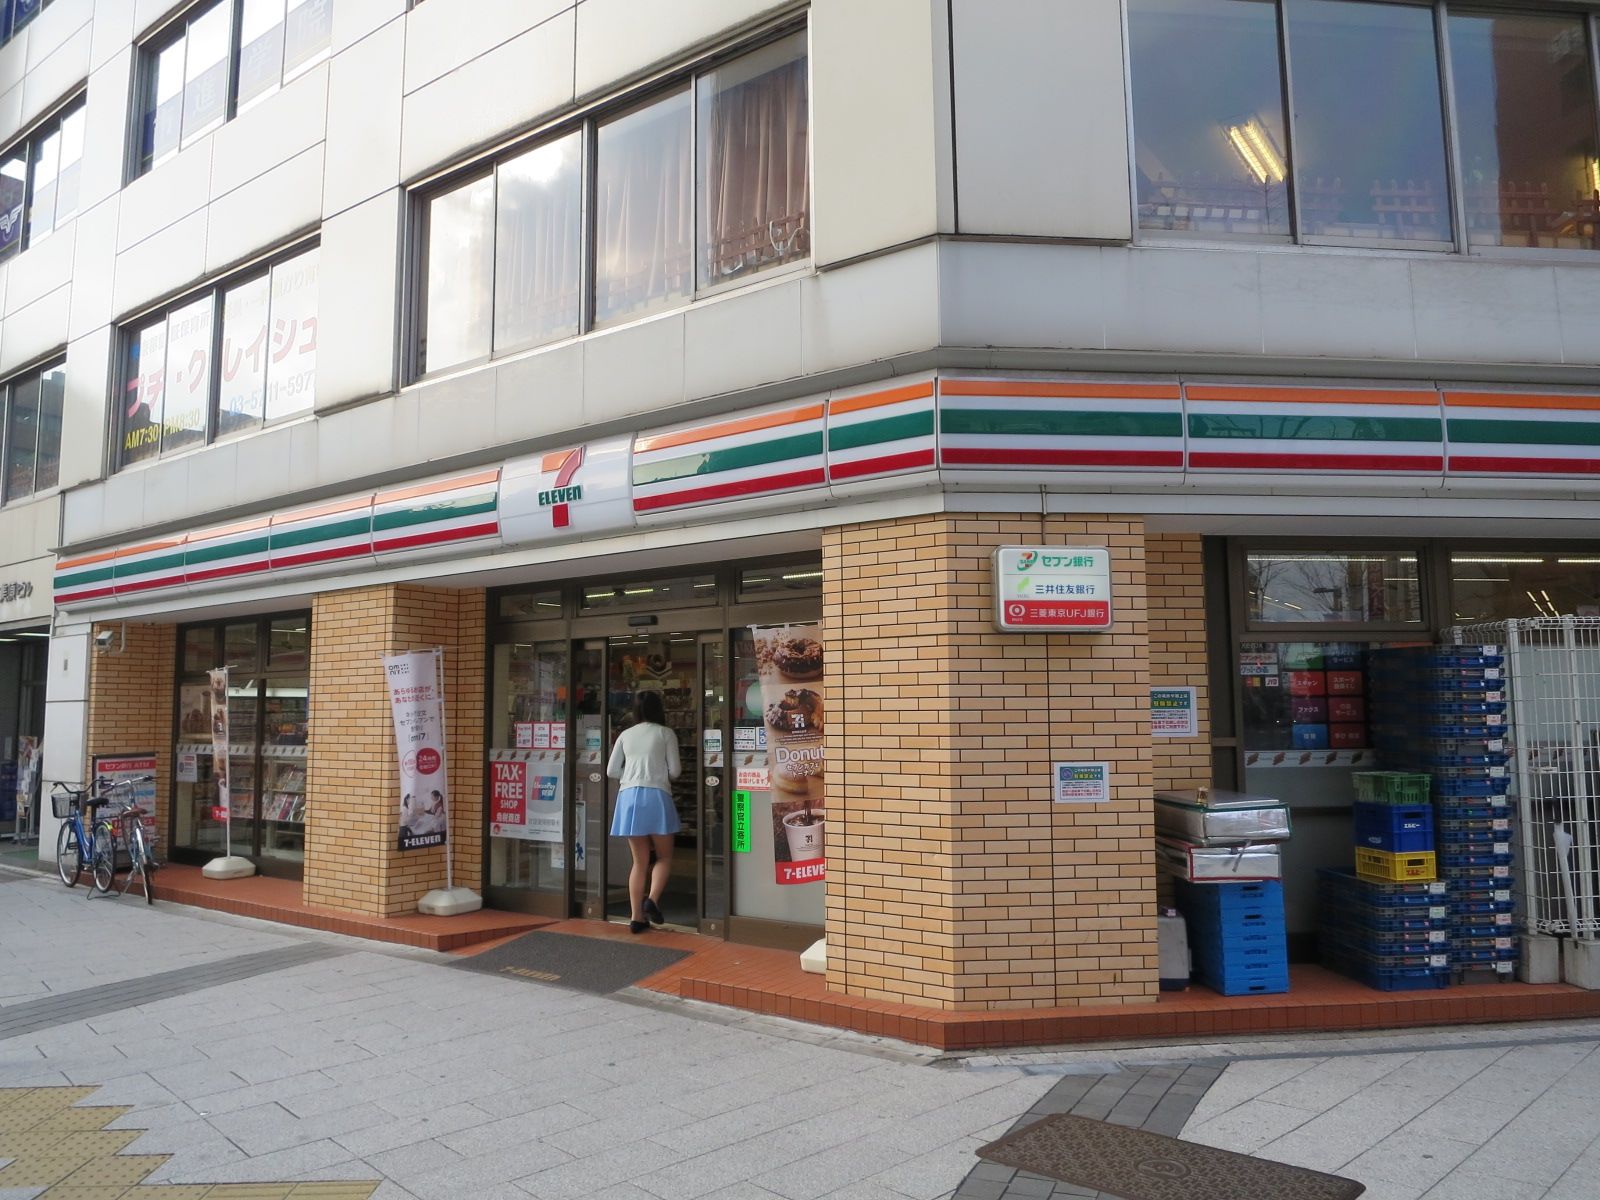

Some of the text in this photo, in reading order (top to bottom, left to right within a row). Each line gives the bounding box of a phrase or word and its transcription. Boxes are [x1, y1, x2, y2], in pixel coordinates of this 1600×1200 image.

[126, 316, 318, 417] プチ・クレイシュ
[1041, 555, 1094, 568] セブン銀行
[1035, 584, 1096, 595] 三井住友銀行
[1030, 608, 1104, 618] 三菱東京UFJ銀行
[495, 781, 523, 799] FREE
[500, 800, 518, 809] SHOP
[783, 863, 825, 880] 7-ELEVE
